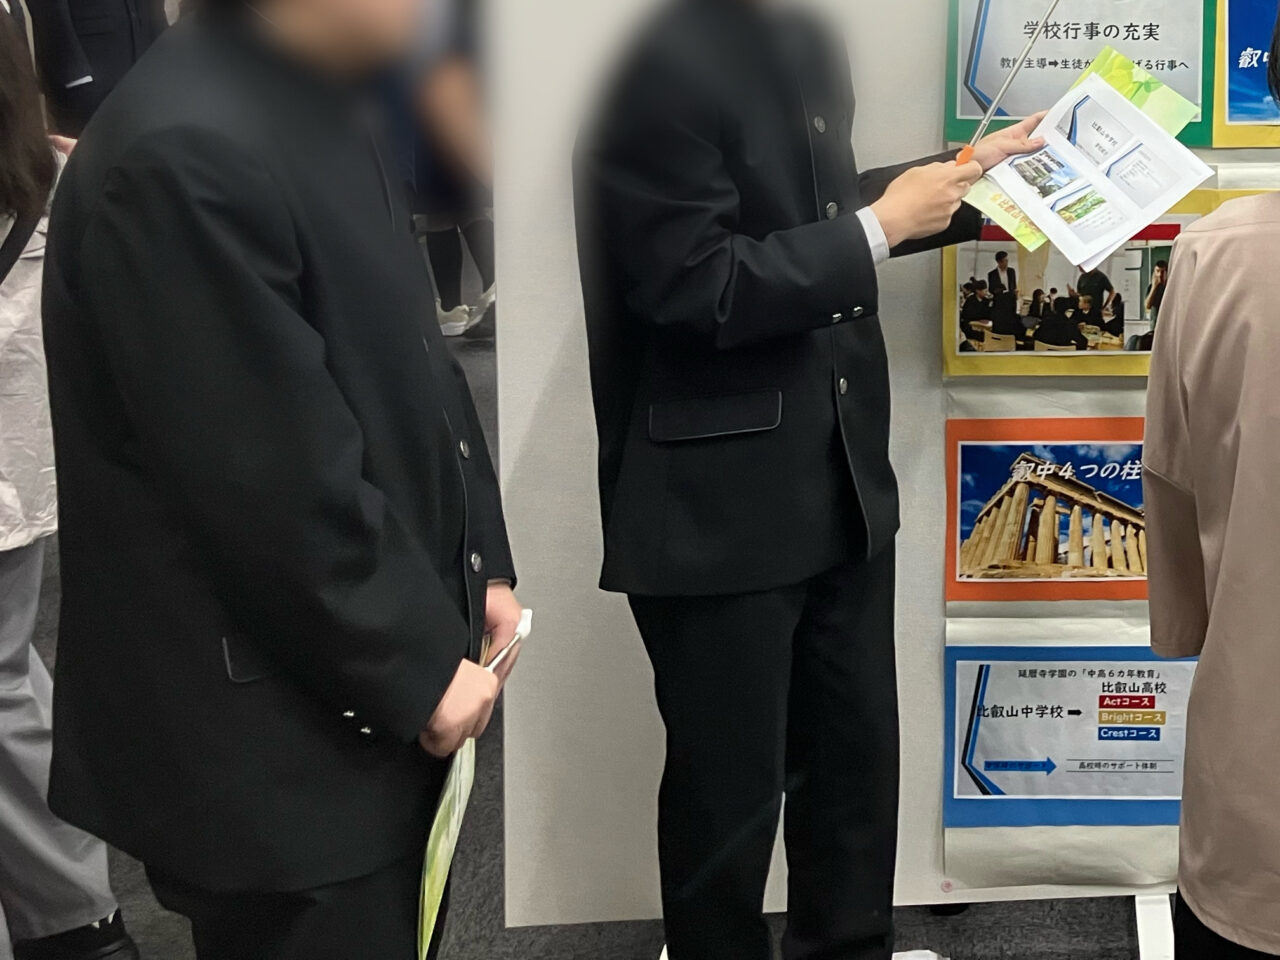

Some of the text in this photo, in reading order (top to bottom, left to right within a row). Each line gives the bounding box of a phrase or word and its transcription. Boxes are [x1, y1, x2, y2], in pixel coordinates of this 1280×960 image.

[1023, 21, 1160, 41] 学校行事の充実
[1102, 681, 1167, 694] 比叡山高校
[1103, 697, 1150, 706] Actコース
[976, 704, 1064, 719] 比叡山中学校
[1100, 728, 1157, 738] Crestコース
